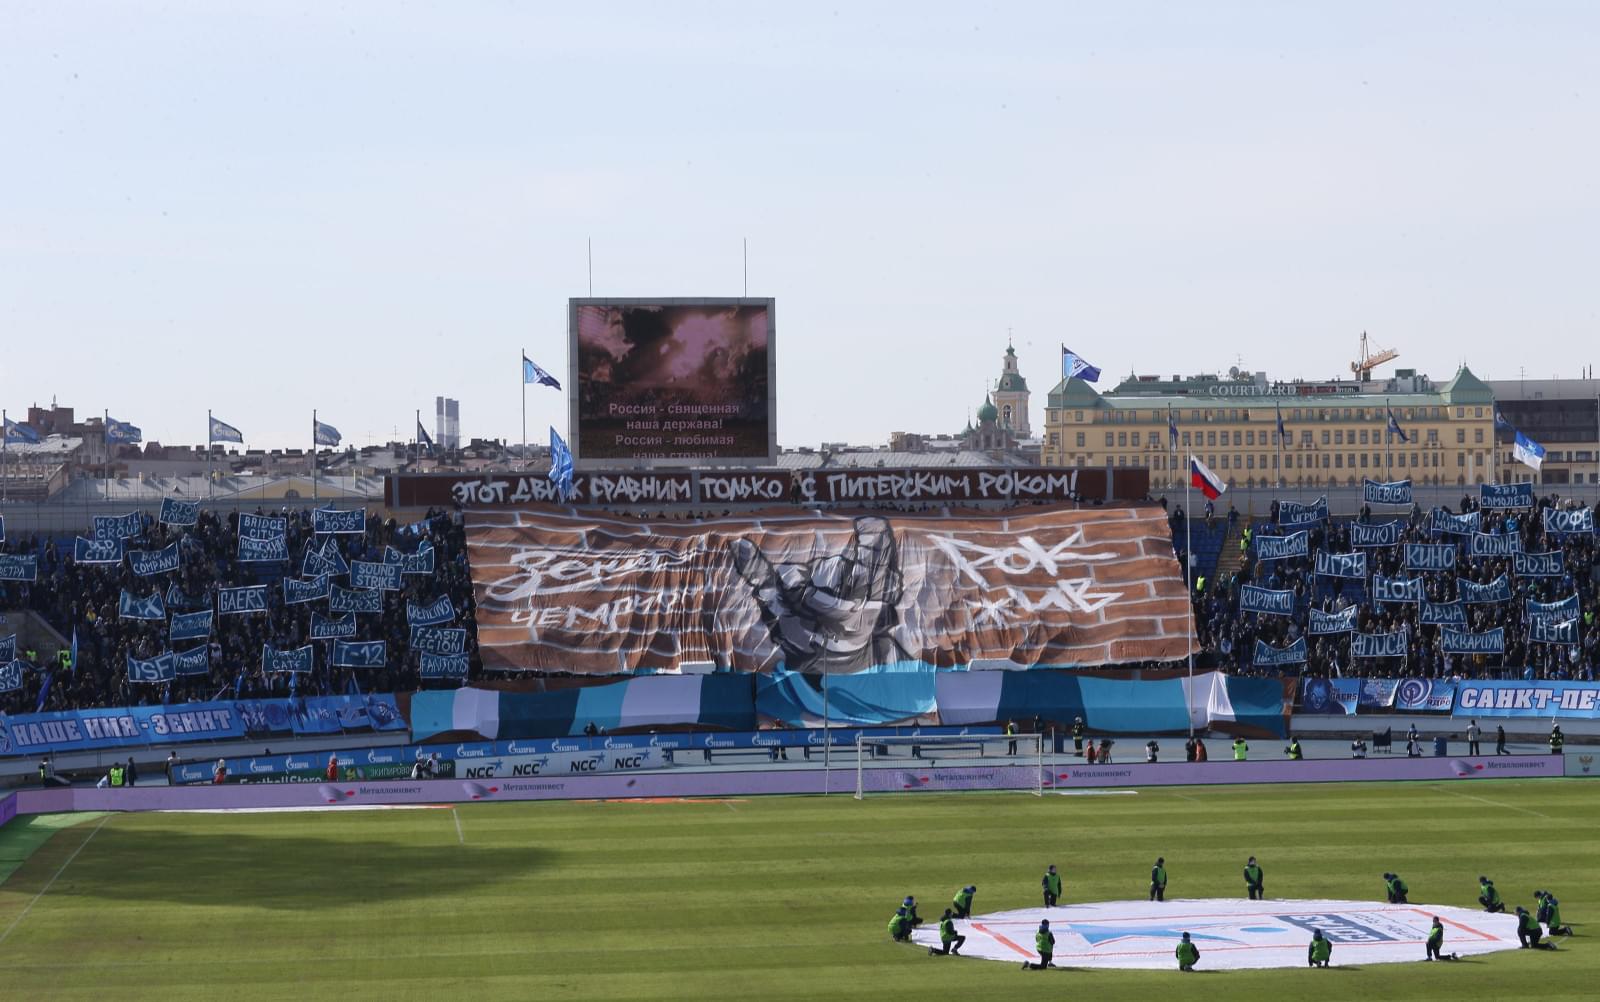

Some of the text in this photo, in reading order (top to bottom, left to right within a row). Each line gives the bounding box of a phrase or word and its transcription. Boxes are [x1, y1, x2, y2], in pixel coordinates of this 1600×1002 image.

[1209, 384, 1296, 396] COURTYARD
[609, 403, 656, 414] Россия
[668, 404, 739, 416] священная
[626, 418, 723, 431] наша держава!
[615, 434, 662, 445] Россия
[674, 434, 735, 445] любимая
[451, 480, 509, 503] ЭТОТ
[590, 475, 691, 503] СРАВНИМ
[699, 476, 783, 501] ТОЛЬКО
[827, 473, 970, 501] ПИТЕРСКИМ
[979, 469, 1078, 499] РОКОМ!
[244, 516, 284, 530] BRIDGE
[324, 520, 355, 531] BOYS
[1545, 508, 1593, 532] КОФЕ
[97, 523, 139, 539] GROUP
[249, 531, 275, 540] CITY
[85, 547, 117, 560] CITY
[1406, 546, 1454, 568] КИНО
[133, 553, 178, 573] COMPANY
[358, 564, 395, 577] SOUND
[356, 575, 395, 588] STRIKE
[417, 627, 458, 641] FLASH
[411, 639, 459, 653] LEGION
[339, 644, 383, 664] T-12
[1460, 688, 1600, 710] САНКТ-ПЕ
[12, 719, 82, 746] НАШЕ
[83, 716, 139, 739] ИМЯ
[151, 709, 231, 735] ЗЕНИТ
[571, 759, 597, 772] NCC
[615, 756, 641, 769] NCC
[466, 766, 494, 778] NCC
[513, 763, 539, 776] NCC
[359, 786, 421, 795] Металлоинвест
